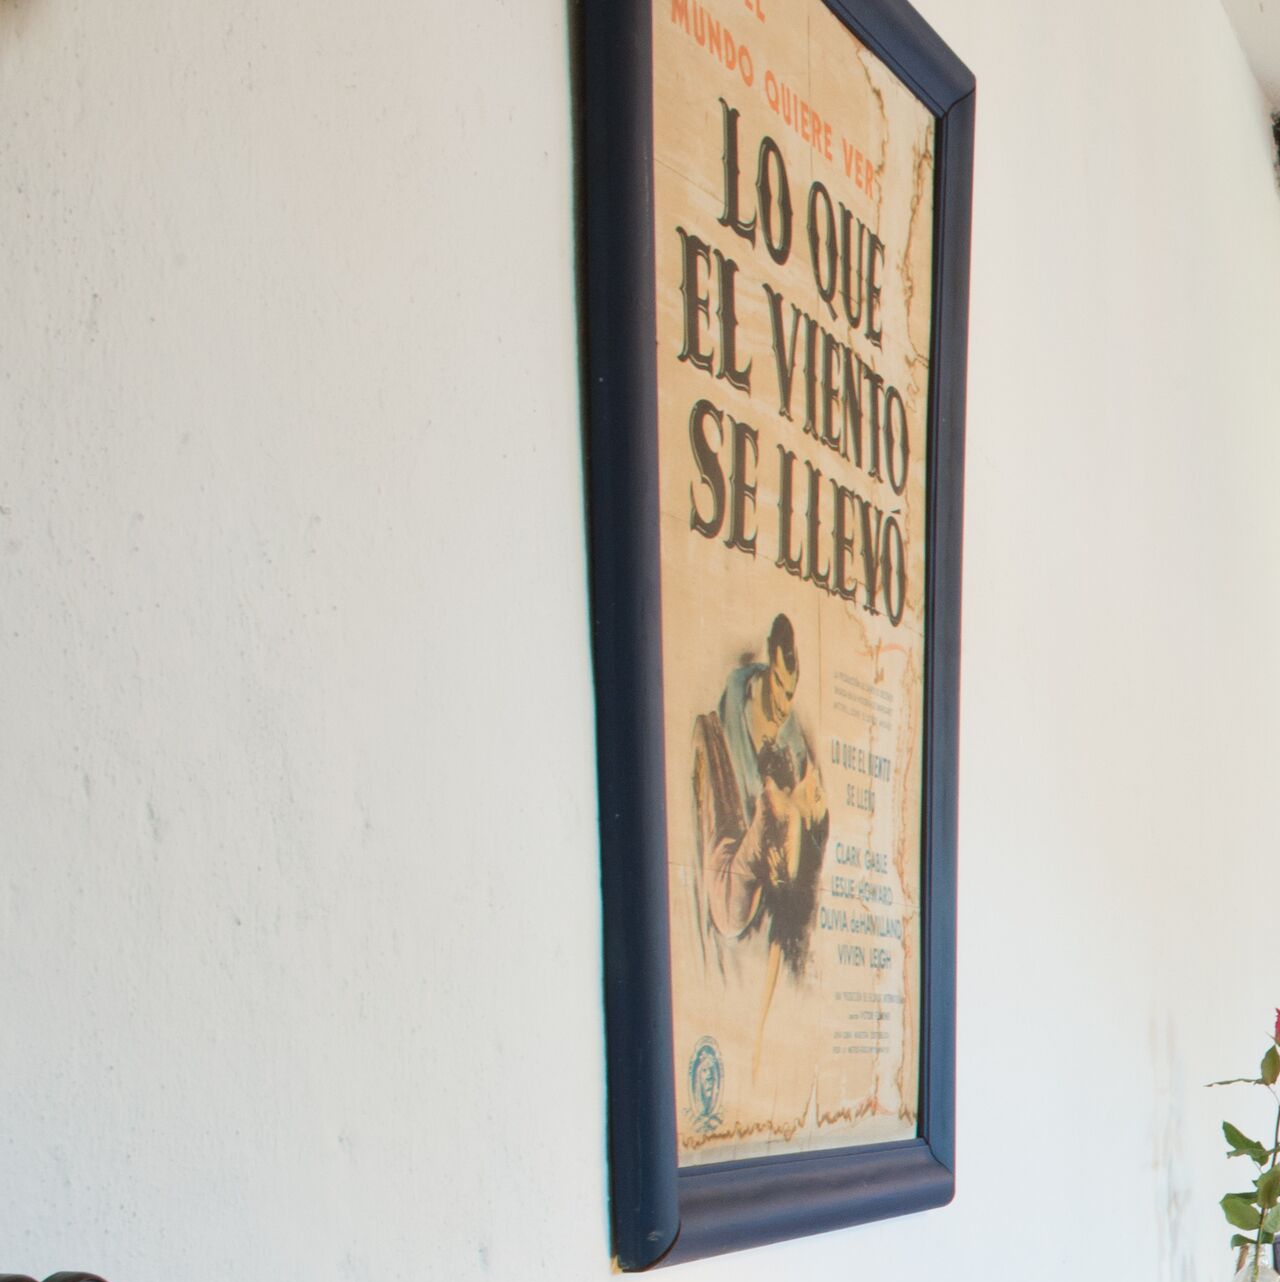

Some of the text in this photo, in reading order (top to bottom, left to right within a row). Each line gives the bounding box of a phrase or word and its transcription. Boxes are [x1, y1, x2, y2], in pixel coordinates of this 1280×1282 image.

[671, 0, 875, 200] MUNDO QUIERE VER
[717, 97, 886, 350] LO QUE
[675, 226, 910, 496] EL VIENTO
[689, 399, 907, 627] SE LLEVÓ
[831, 739, 840, 764] LO
[842, 744, 856, 770] QUE
[858, 749, 866, 773] EL
[847, 783, 855, 807] SE
[836, 842, 888, 874] CLARK GABLE
[831, 876, 893, 905] LESLIE HOWARD
[820, 906, 848, 931] OLIVIA
[838, 944, 892, 970] VIVIEN LEIGH
